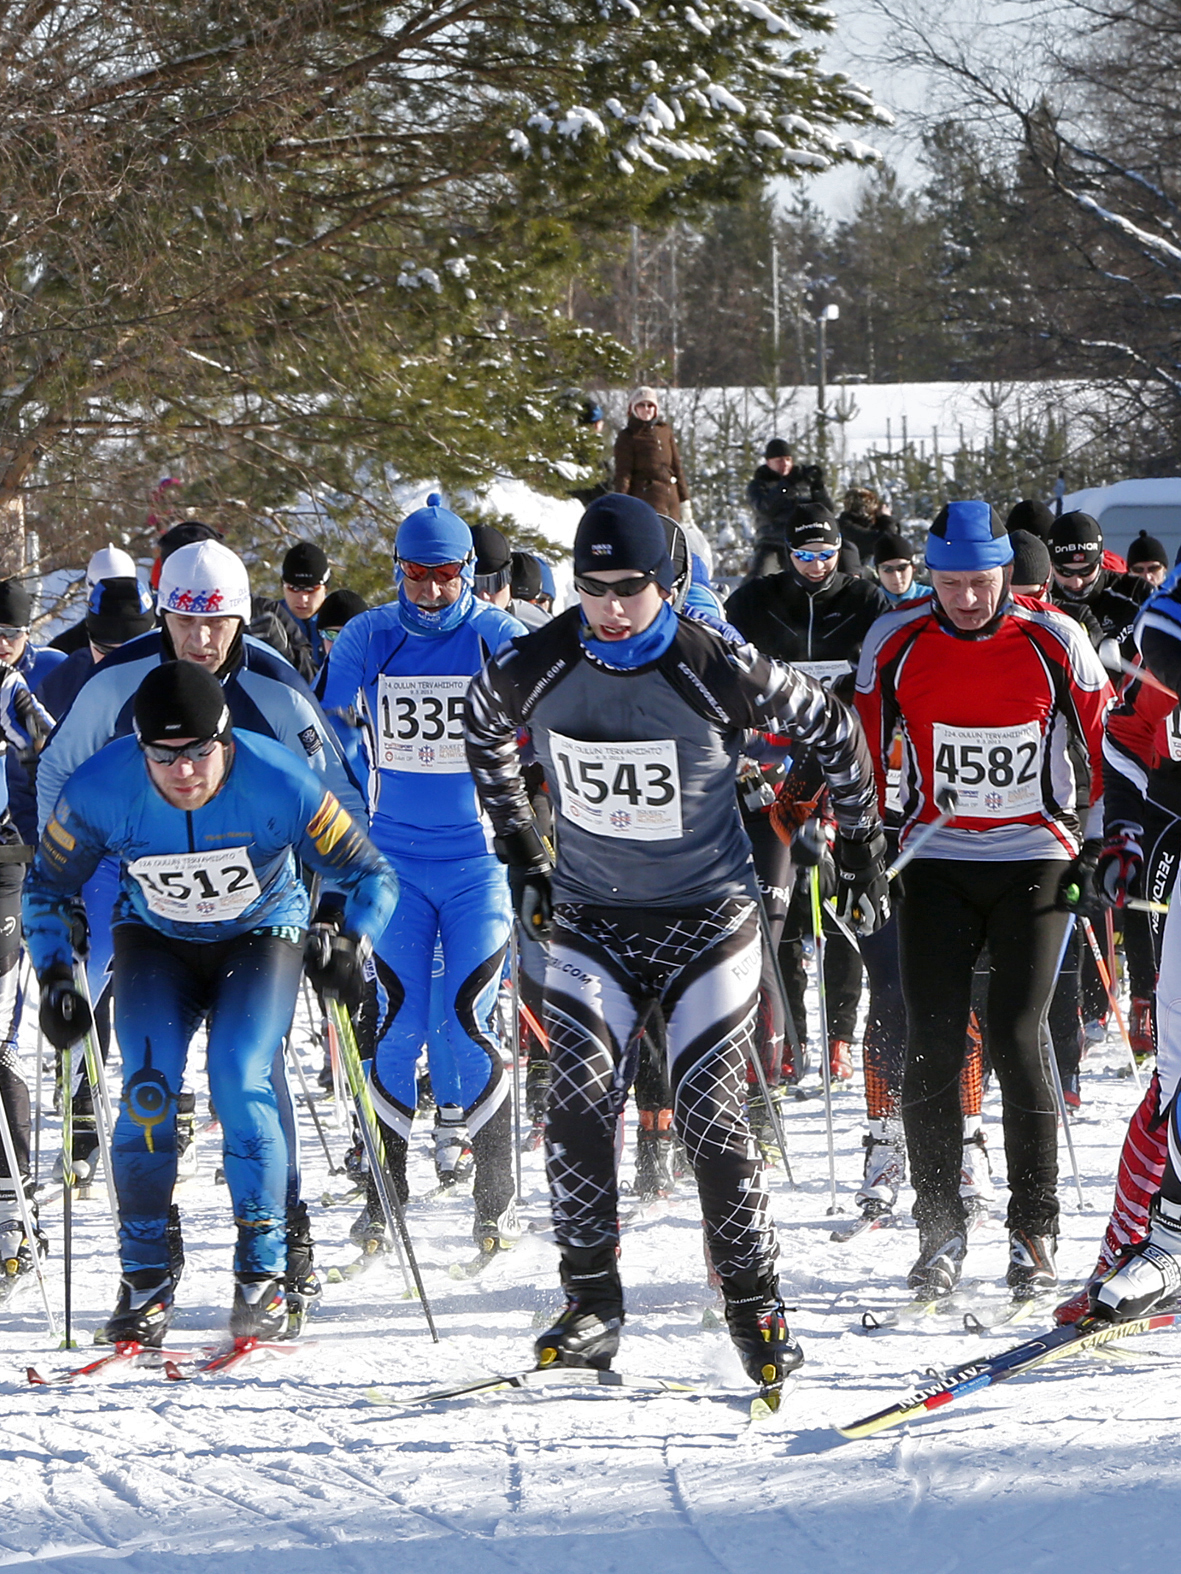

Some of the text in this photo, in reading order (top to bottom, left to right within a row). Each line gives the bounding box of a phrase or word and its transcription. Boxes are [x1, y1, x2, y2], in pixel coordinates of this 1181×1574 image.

[1054, 542, 1098, 553] DnB NOR
[382, 694, 467, 741] 1335
[557, 752, 675, 807] 1543
[935, 741, 1038, 788] 4582
[135, 865, 254, 900] 1512
[731, 946, 762, 981] FUTUR
[1080, 1320, 1150, 1351] SALOMON
